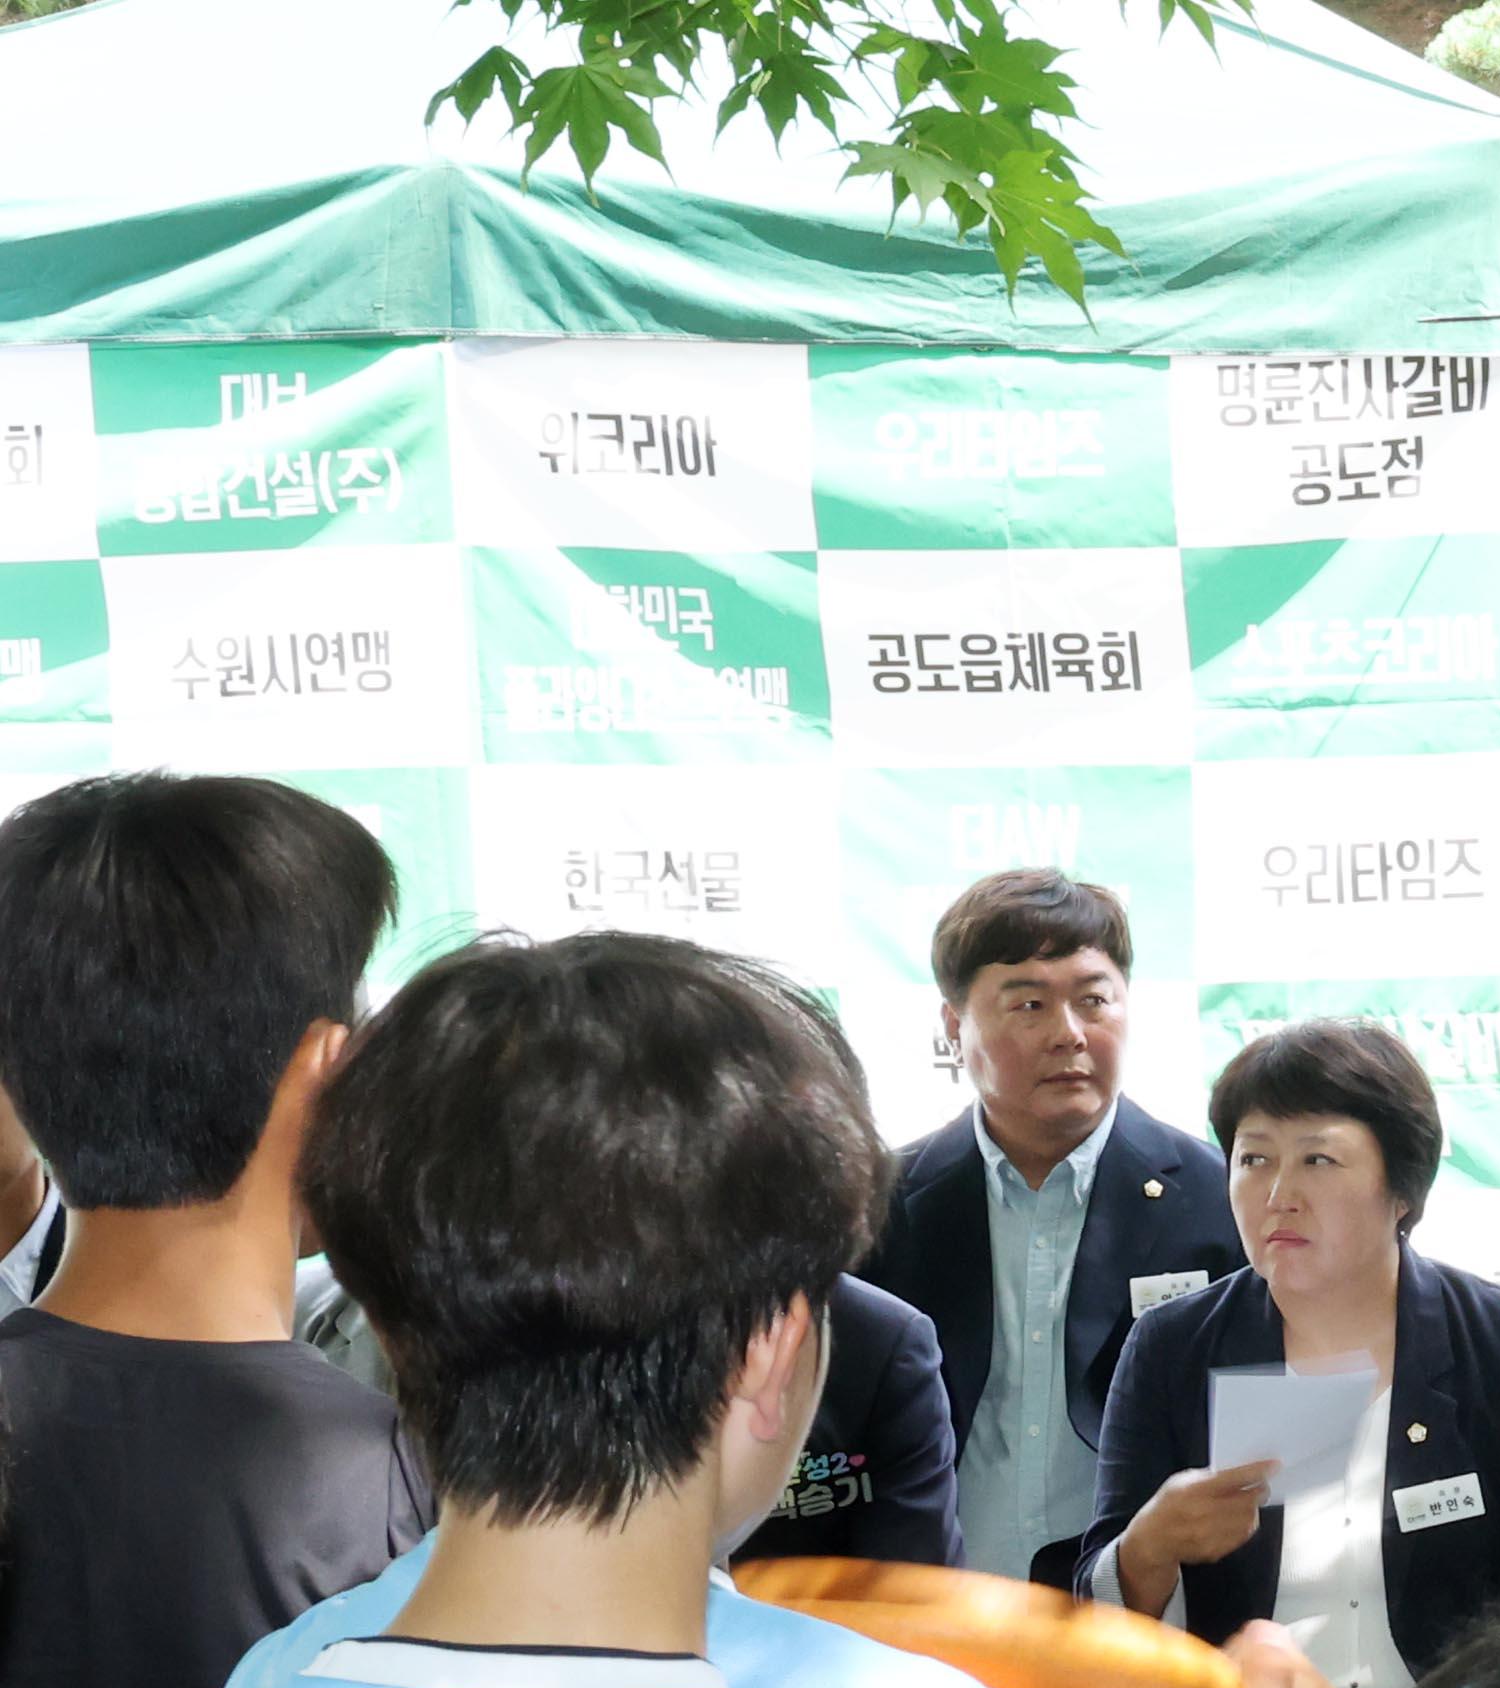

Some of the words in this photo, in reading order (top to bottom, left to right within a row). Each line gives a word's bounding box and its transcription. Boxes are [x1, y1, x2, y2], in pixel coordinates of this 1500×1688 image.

[1216, 357, 1491, 427] 명륜진사갈비
[538, 411, 718, 477] 위코리아
[1289, 435, 1425, 507] 공도점
[170, 629, 394, 700] 수원시연맹
[864, 630, 1144, 695] 공도읍체육회
[564, 850, 742, 913] 한국선물
[1262, 838, 1486, 906] 우리타임즈
